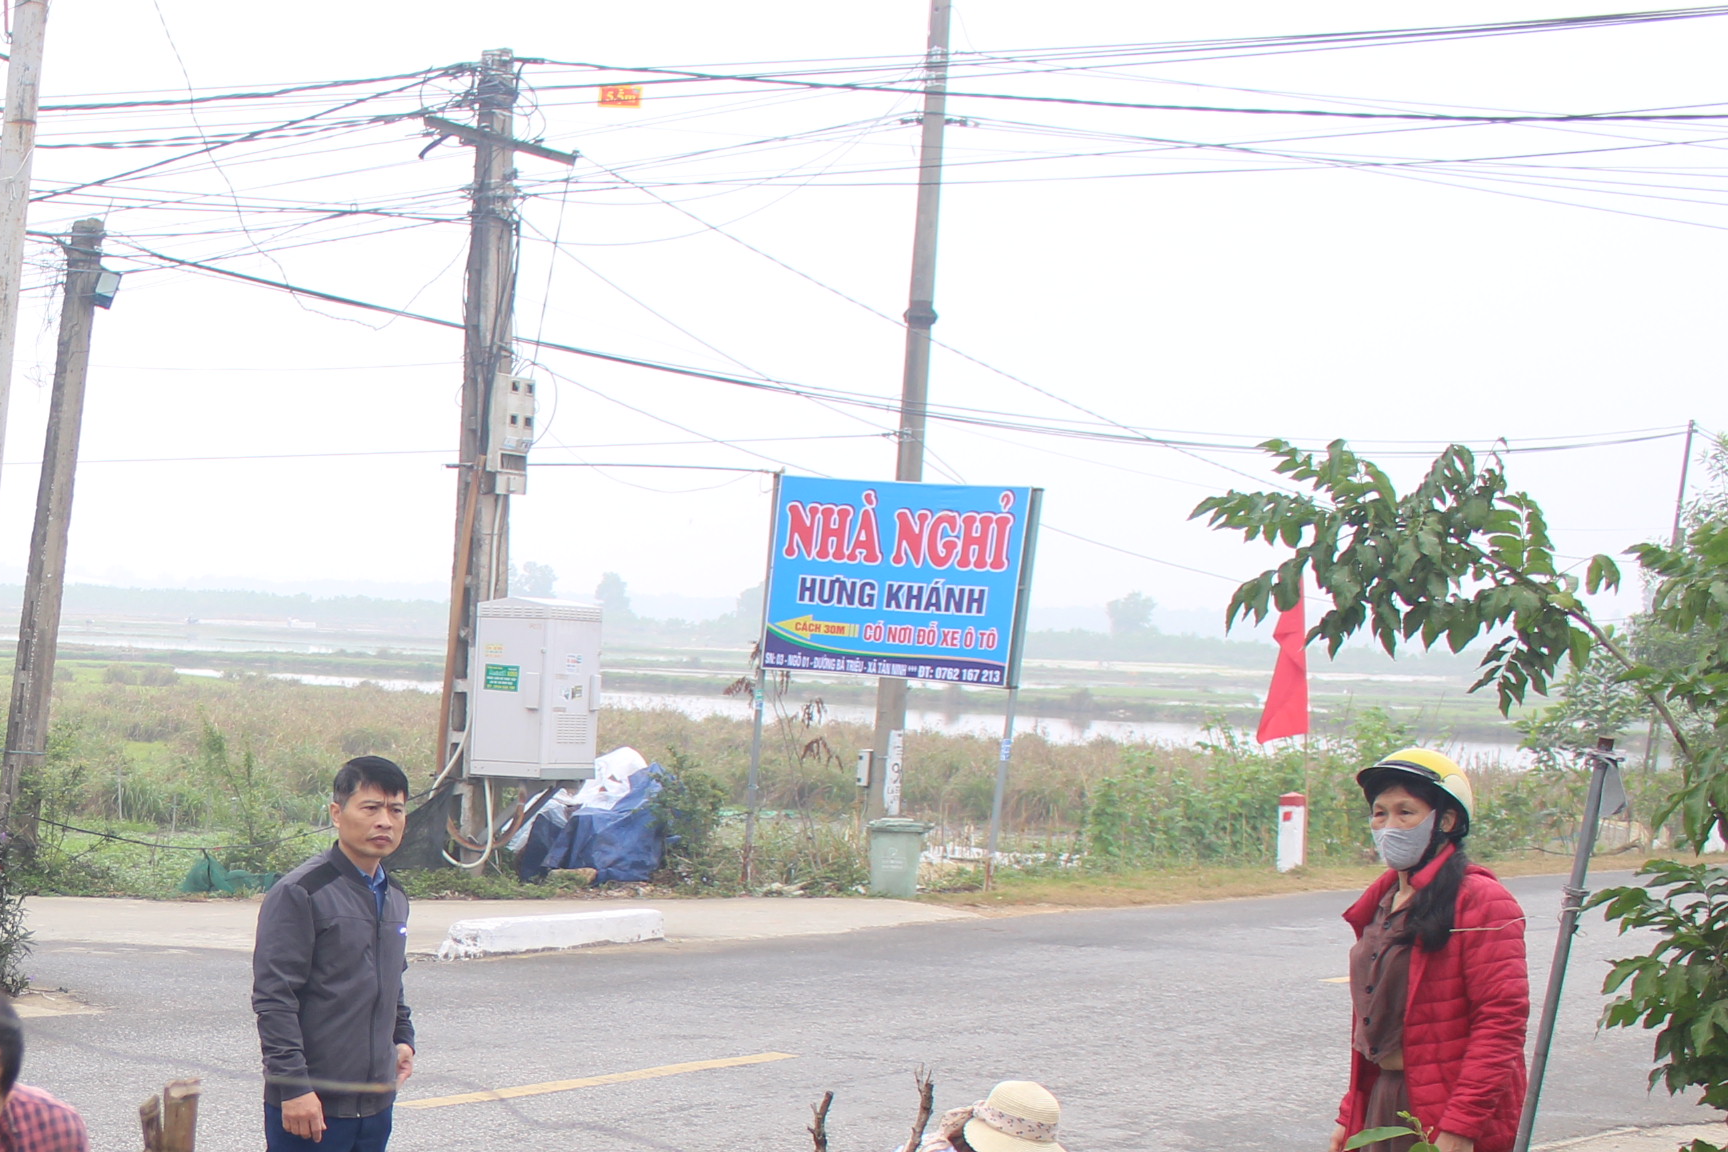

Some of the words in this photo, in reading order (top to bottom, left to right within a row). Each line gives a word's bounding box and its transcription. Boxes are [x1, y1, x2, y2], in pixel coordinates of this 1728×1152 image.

[783, 489, 882, 564] NHÀ
[891, 489, 1015, 570] NGHỈ
[797, 574, 878, 610] HƯNG
[883, 579, 988, 616] KHÁNH
[794, 620, 822, 633] CÁCH
[824, 624, 845, 636] 30M
[863, 620, 884, 642] CÓ
[887, 625, 913, 644] NƠI
[917, 621, 938, 646] ĐỖ
[941, 629, 959, 648] XE
[964, 625, 976, 649] Ô
[979, 628, 998, 650] TÔ
[765, 652, 775, 664] SN:
[776, 653, 784, 665] 03
[787, 652, 801, 667] NGÕ
[802, 655, 809, 667] 01
[813, 654, 836, 670] ĐƯỜNG
[867, 659, 878, 673] XÃ
[878, 659, 891, 675] TÂN
[891, 663, 907, 676] NINH
[918, 665, 933, 678] ĐT:
[935, 667, 960, 680] 0762
[961, 668, 980, 682] 167
[981, 670, 1000, 683] 213
